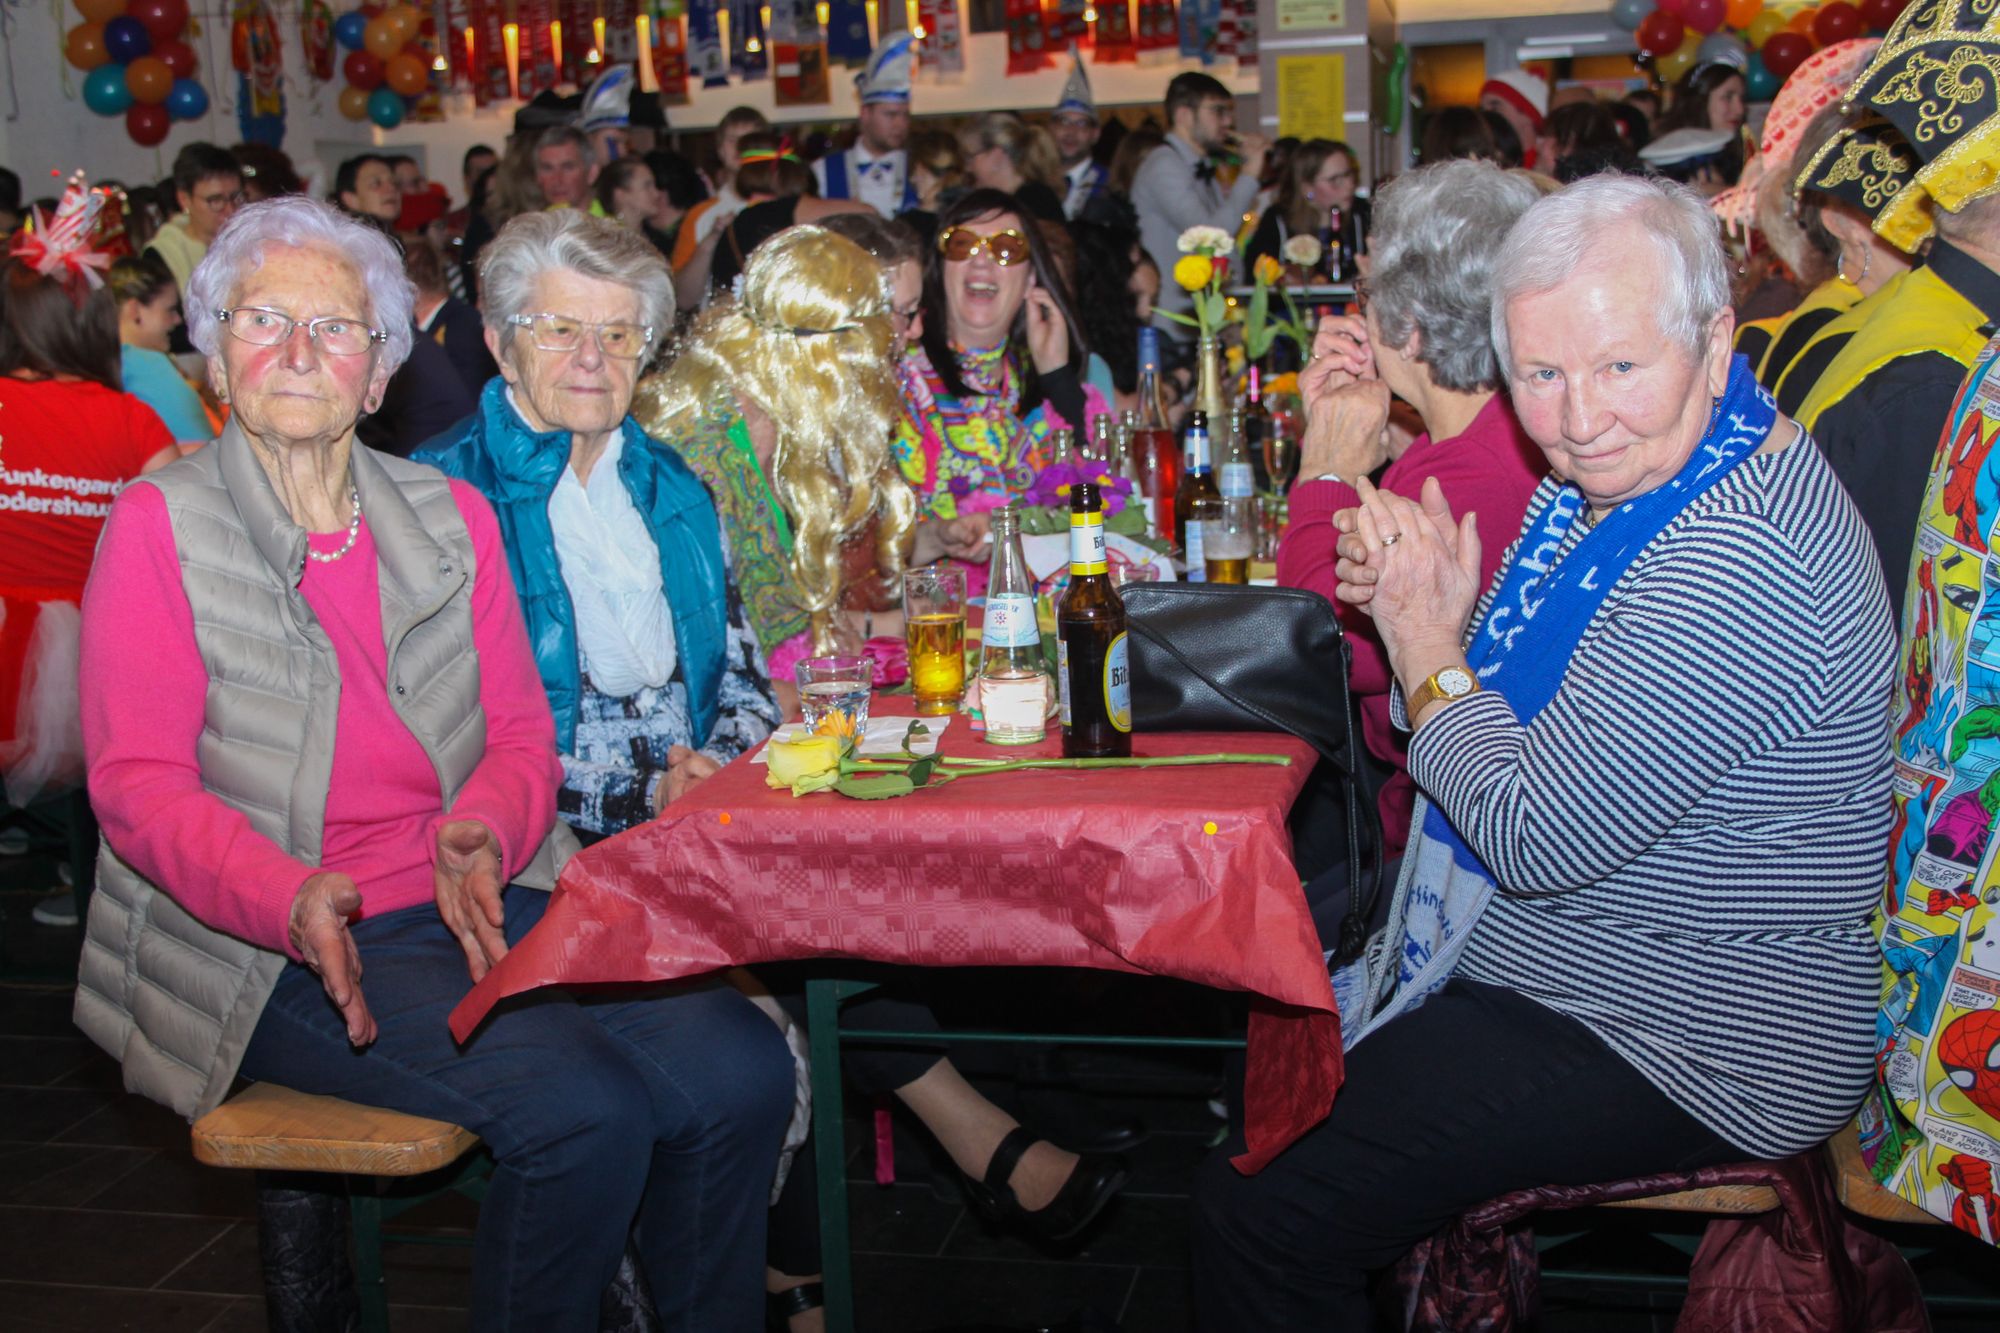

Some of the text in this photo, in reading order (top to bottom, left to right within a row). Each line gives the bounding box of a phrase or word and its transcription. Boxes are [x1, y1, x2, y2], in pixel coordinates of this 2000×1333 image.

[0, 458, 125, 496] unkengard
[1111, 666, 1128, 688] Bit
[1943, 869, 1964, 880] ONE
[1927, 1127, 1954, 1144] WERE
[1961, 1134, 1985, 1147] THEN
